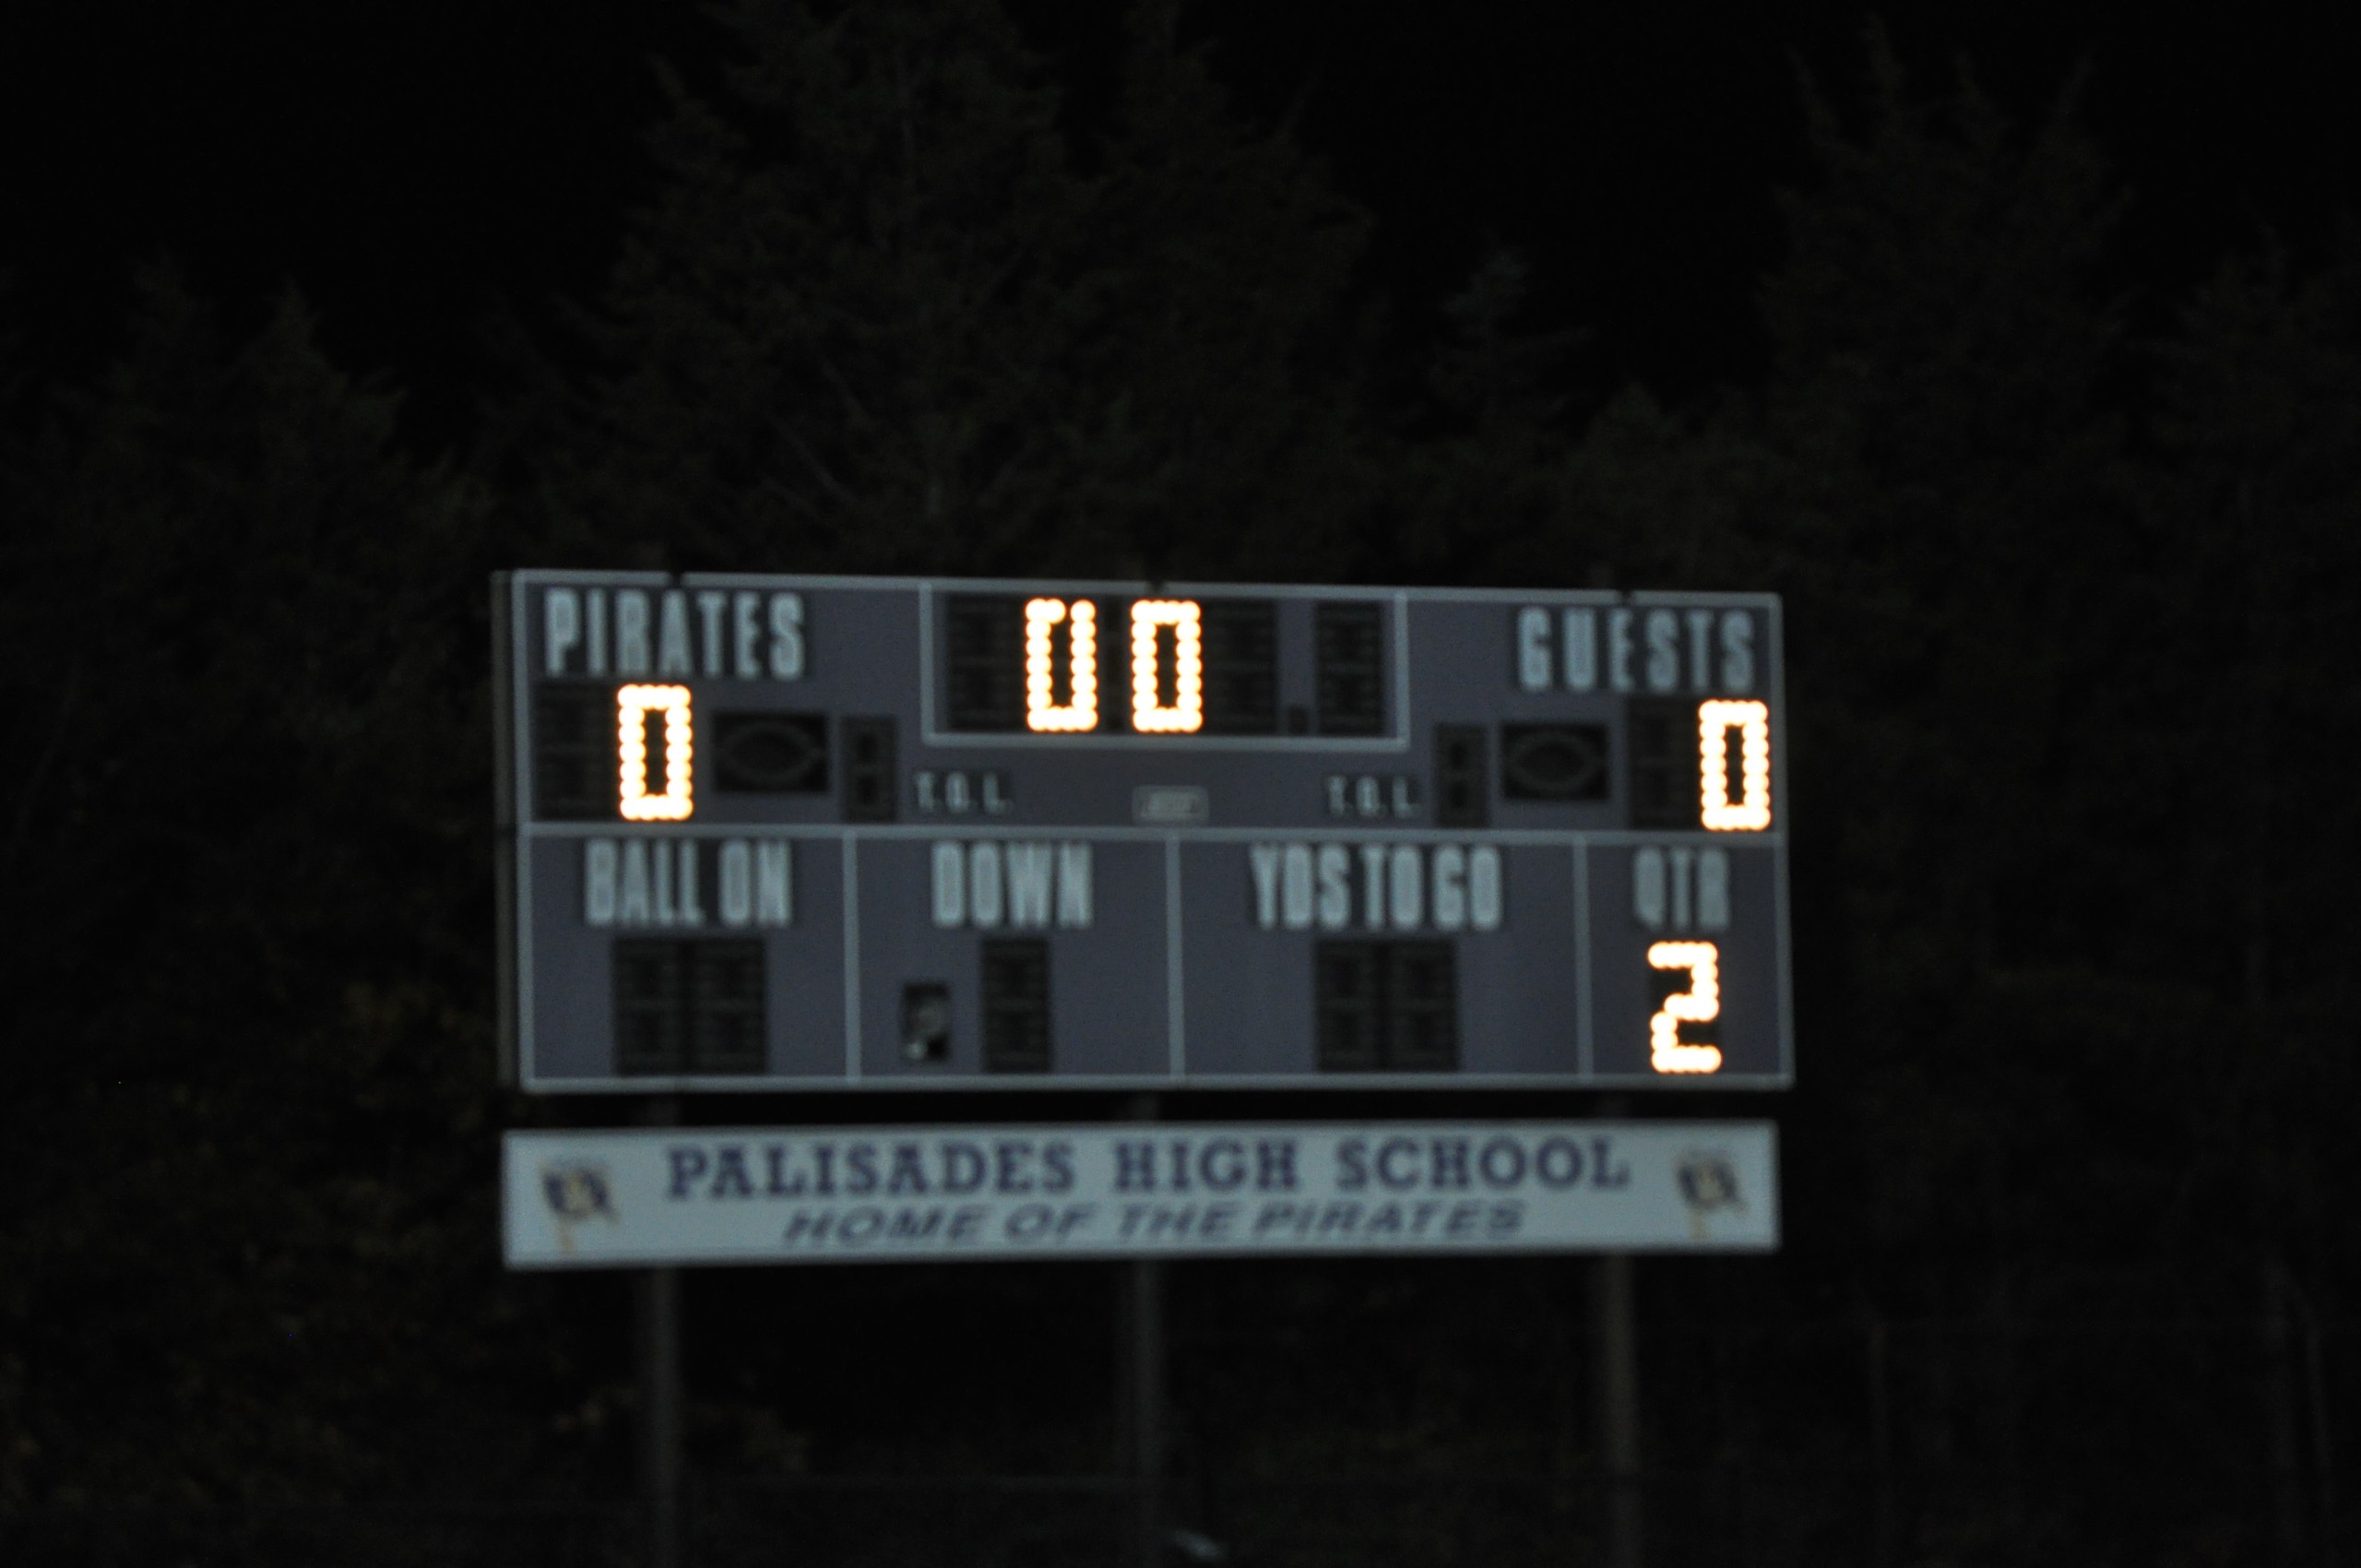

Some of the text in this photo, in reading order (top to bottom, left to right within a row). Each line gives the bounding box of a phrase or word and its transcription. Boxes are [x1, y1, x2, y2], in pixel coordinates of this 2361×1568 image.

[543, 587, 807, 681] PIRATES
[1516, 605, 1755, 693] GUESTS
[616, 683, 694, 821] 0
[1698, 699, 1771, 832] 0
[584, 839, 794, 926] BALL ON
[931, 840, 1095, 927] DOWN
[1249, 843, 1503, 932] YDS TO GO
[1631, 846, 1731, 930] QTR
[1646, 940, 1722, 1074] 2
[663, 1135, 1631, 1201] PALISADES HIGH SCHOOL
[784, 1200, 1526, 1248] HOME OF THE PIRATES
